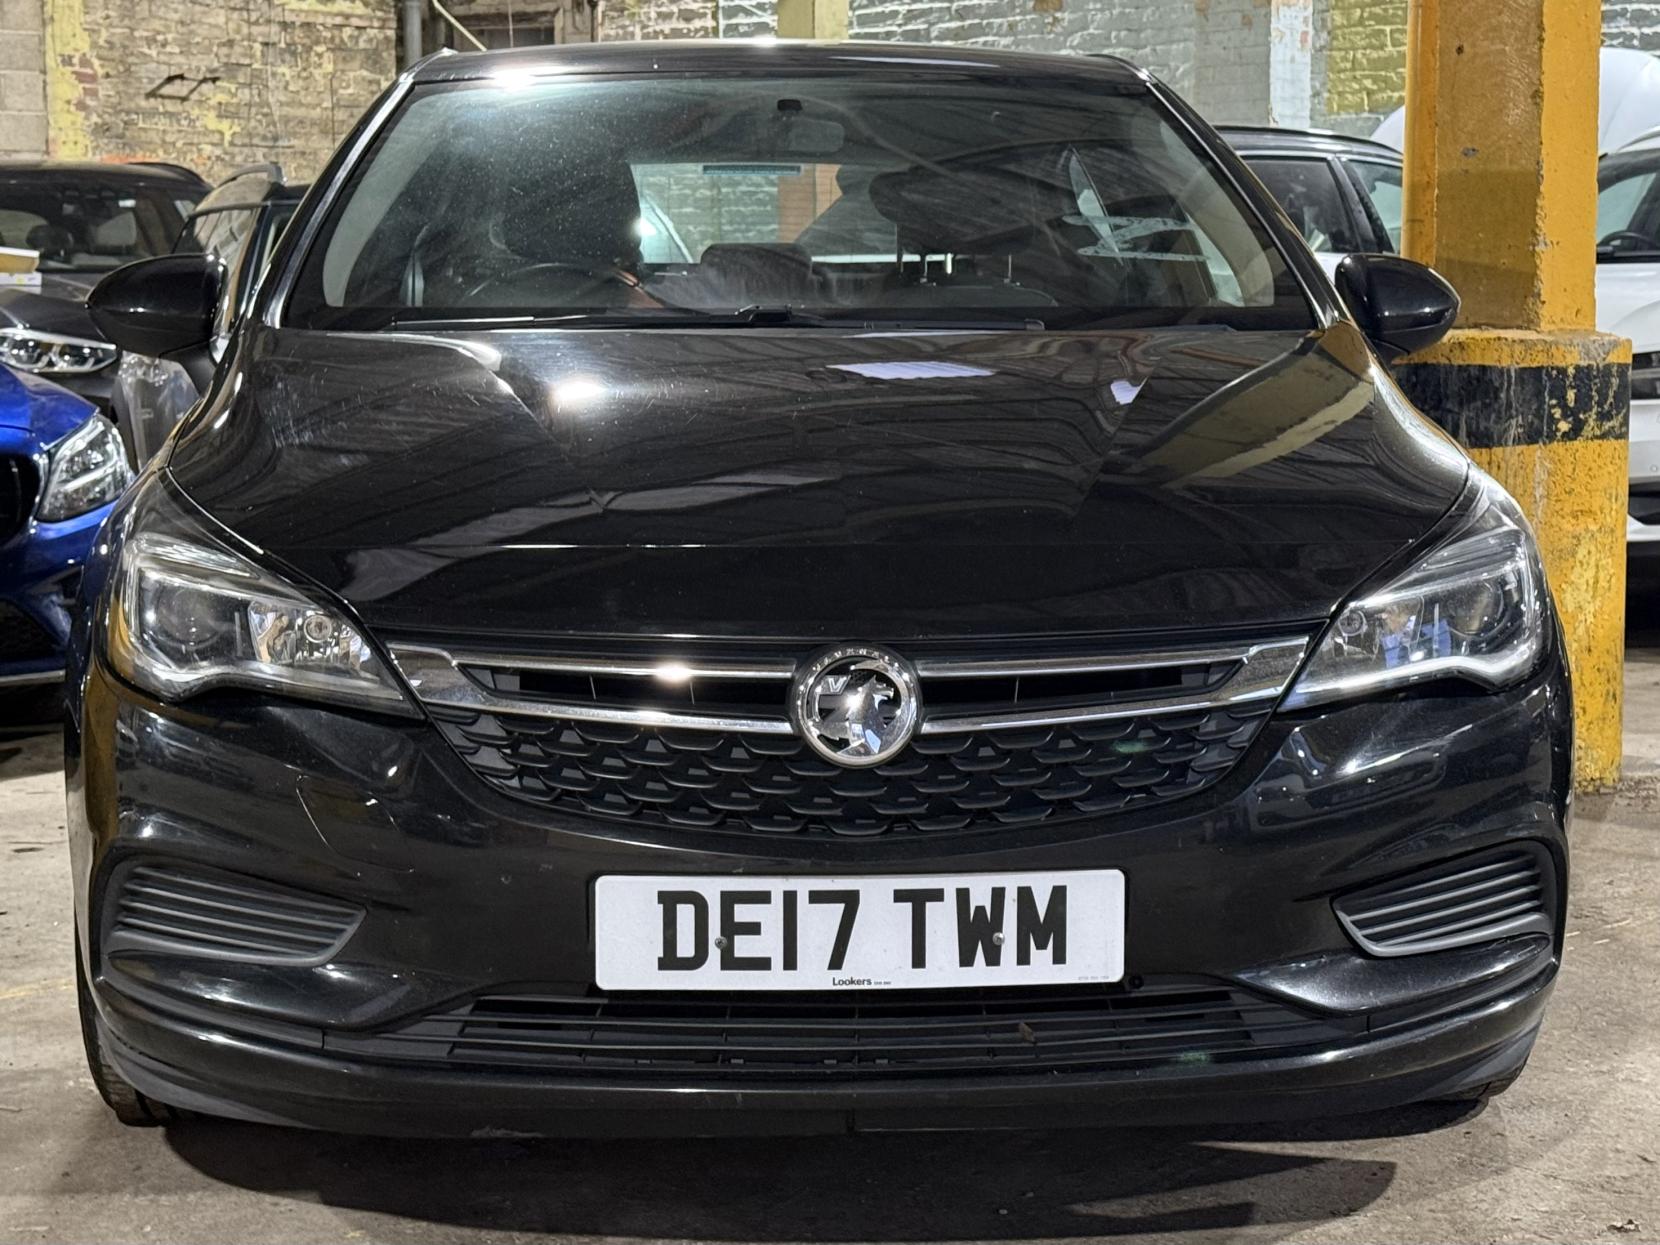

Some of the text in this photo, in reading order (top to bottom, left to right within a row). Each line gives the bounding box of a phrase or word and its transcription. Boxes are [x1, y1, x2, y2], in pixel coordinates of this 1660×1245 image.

[828, 676, 848, 693] V
[657, 885, 1068, 971] DE17 TWM
[832, 976, 872, 986] Lookers
